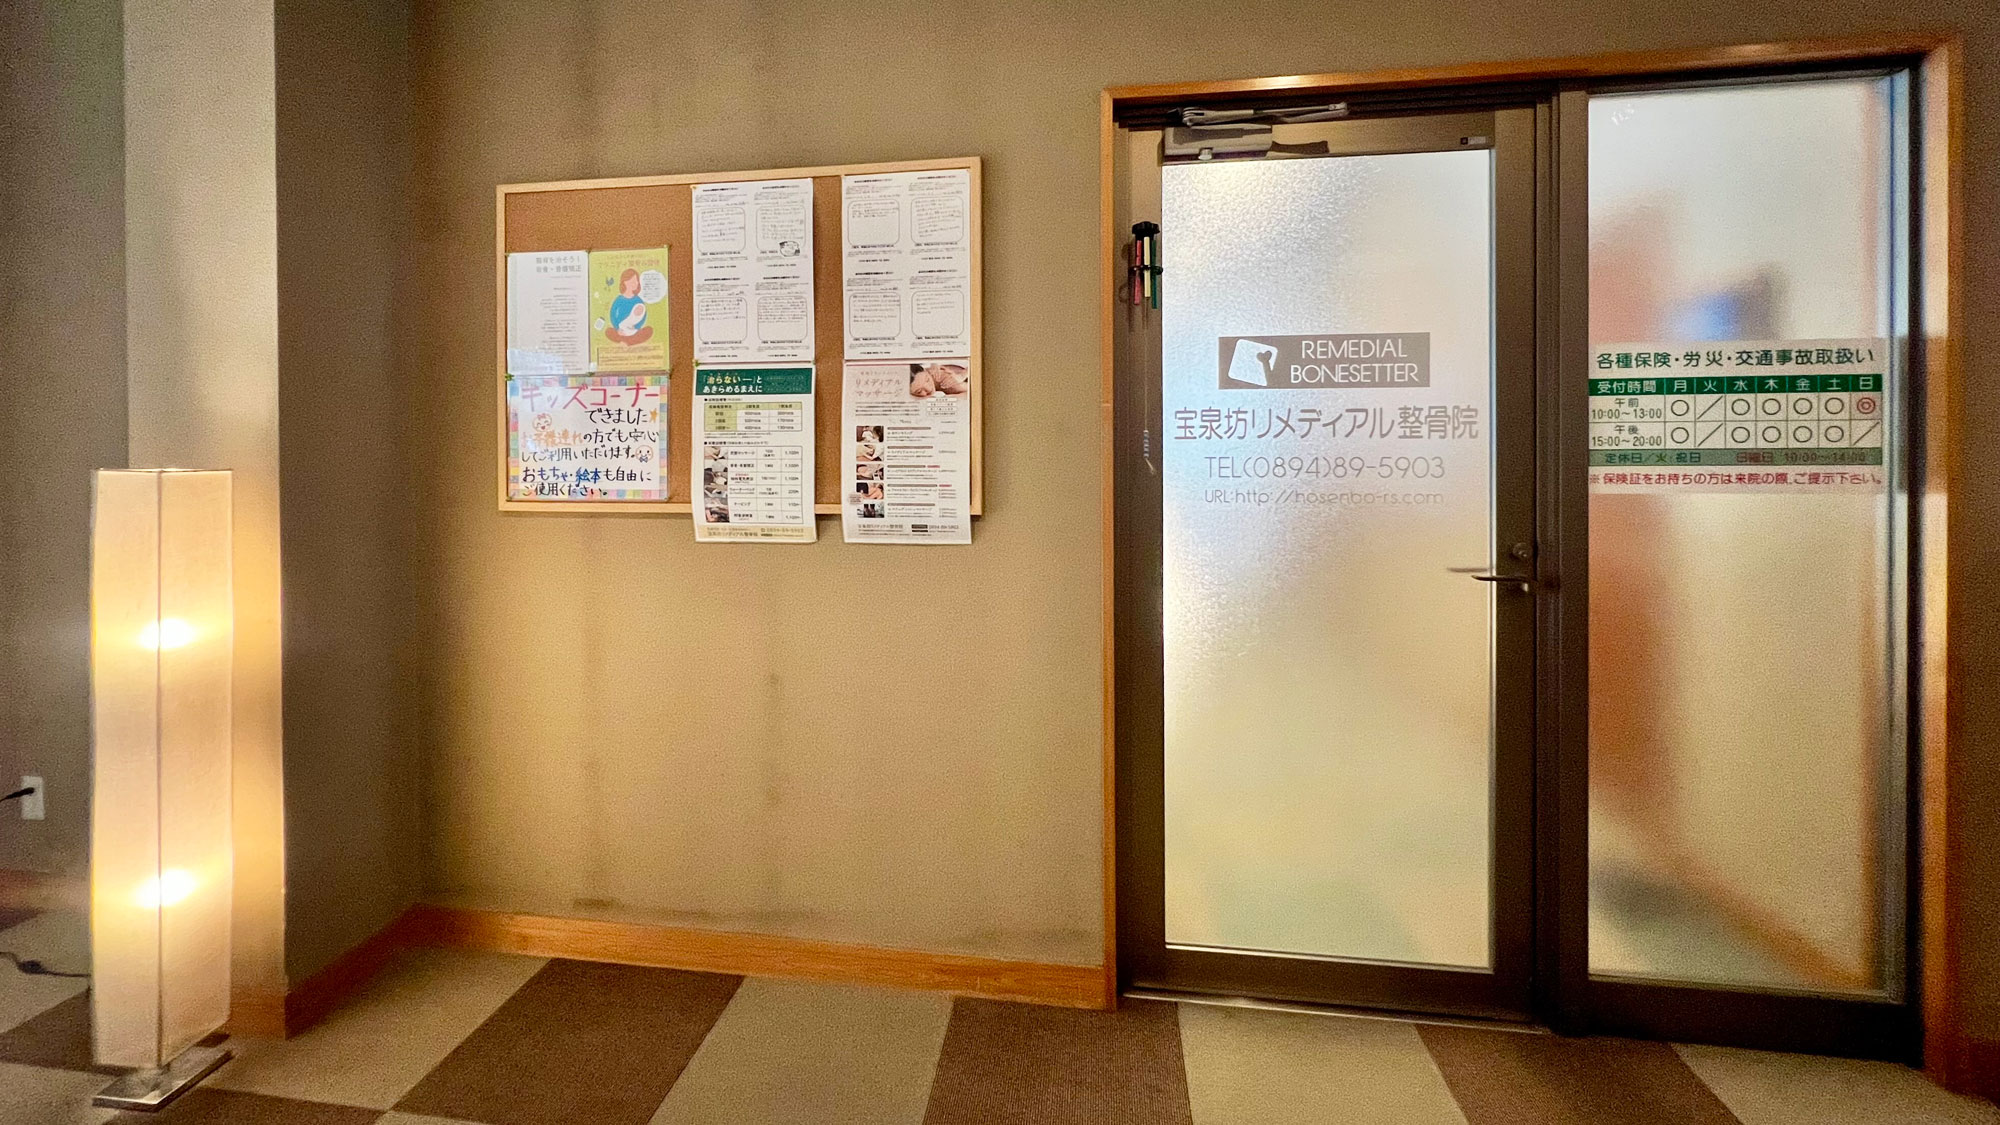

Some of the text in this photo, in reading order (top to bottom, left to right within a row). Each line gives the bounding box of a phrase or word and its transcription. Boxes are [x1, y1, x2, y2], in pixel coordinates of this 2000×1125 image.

[1301, 338, 1408, 360] REMEDIAL
[1596, 348, 1874, 369] 各種保険・労災・交通事故取扱い
[1290, 362, 1419, 384] BONESETTER
[703, 385, 763, 394] あきらめるまえに
[1597, 377, 1873, 393] 受付時間 月 火 水 木 金 土 日
[521, 382, 660, 412] キッズコーナー
[1614, 398, 1639, 408] 午前
[1173, 404, 1479, 440] 宝泉坊リメディアル整骨院
[1614, 425, 1639, 435] 午後
[1204, 456, 1446, 479] TEL(0894)89-5903
